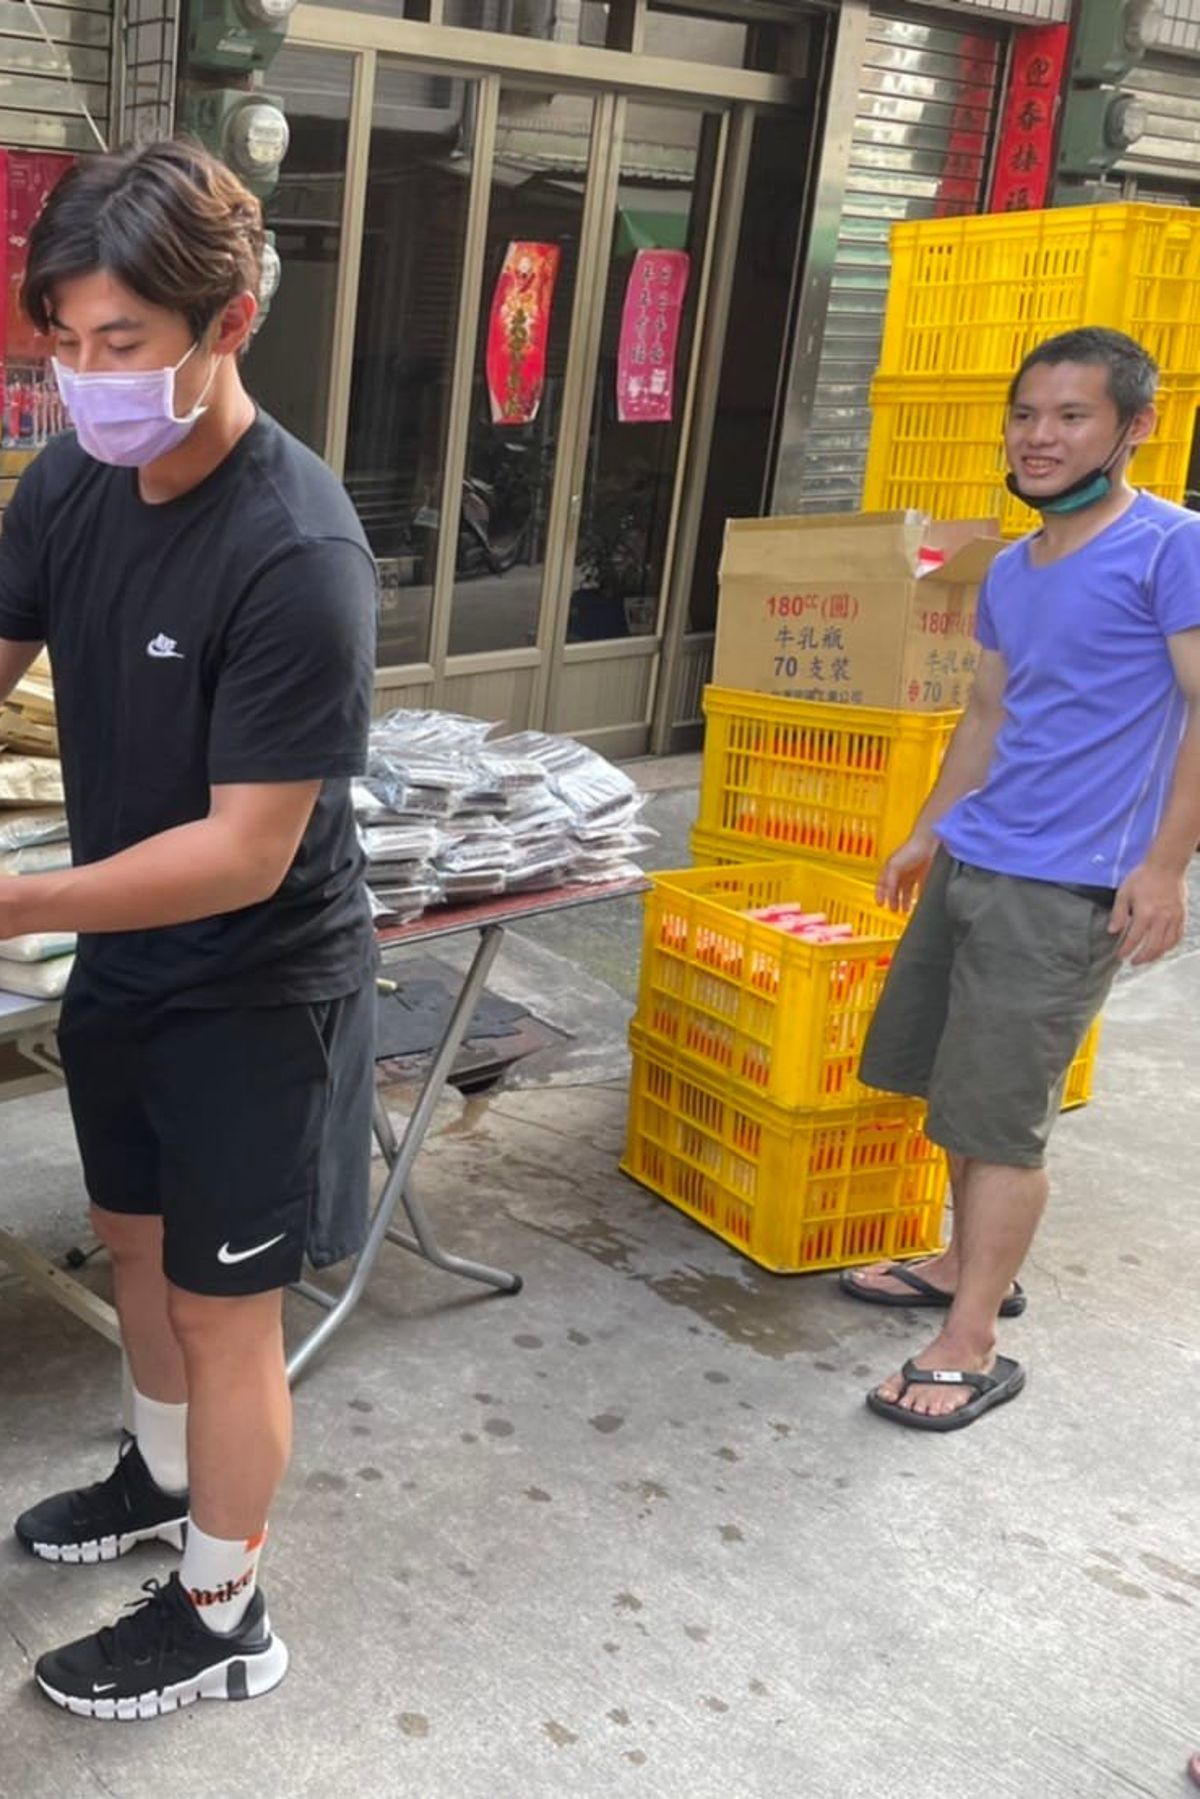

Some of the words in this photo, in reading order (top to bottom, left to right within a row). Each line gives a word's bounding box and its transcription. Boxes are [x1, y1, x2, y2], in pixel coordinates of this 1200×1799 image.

[775, 625, 845, 650] 牛乳瓶
[774, 657, 798, 677] 70
